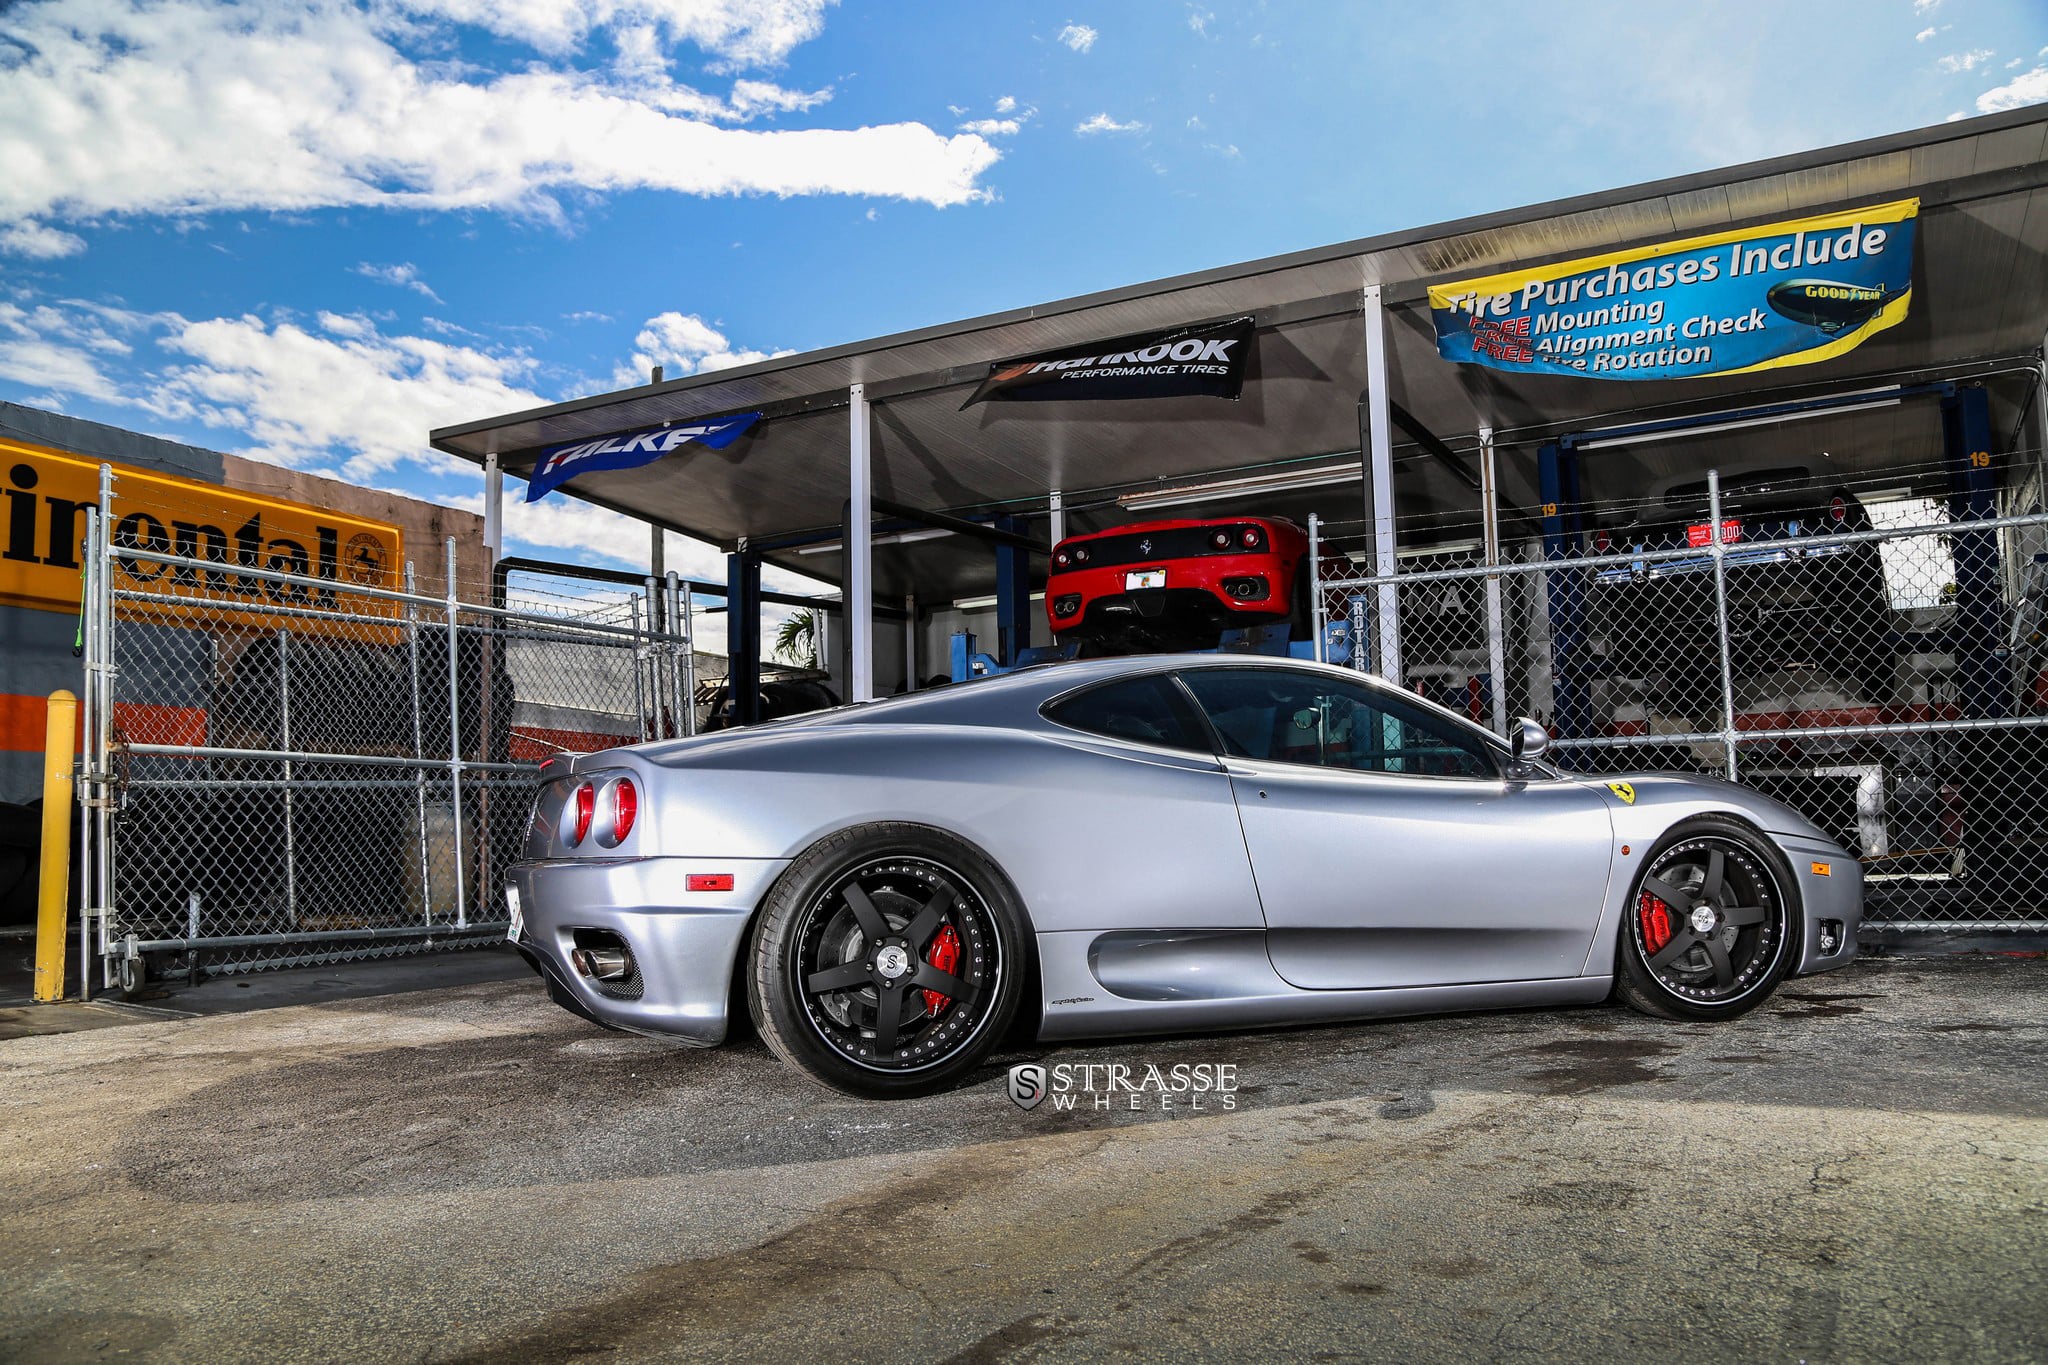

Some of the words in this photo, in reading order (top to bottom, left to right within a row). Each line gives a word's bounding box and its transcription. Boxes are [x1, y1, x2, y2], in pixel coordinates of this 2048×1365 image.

[1446, 290, 1513, 319] Tire
[1520, 252, 1720, 311] Purchases
[1730, 223, 1888, 278] Include
[1535, 300, 1664, 335] Mounting
[1536, 322, 1675, 357] Alignment
[1682, 309, 1767, 338] Check
[1060, 365, 1179, 380] PERFORMANCE
[1182, 364, 1230, 375] TIRES
[1472, 337, 1535, 363] FREE
[1593, 344, 1713, 372] Rotation
[1969, 451, 1991, 468] 19
[1541, 502, 1558, 518] 19
[0, 463, 341, 609] inental
